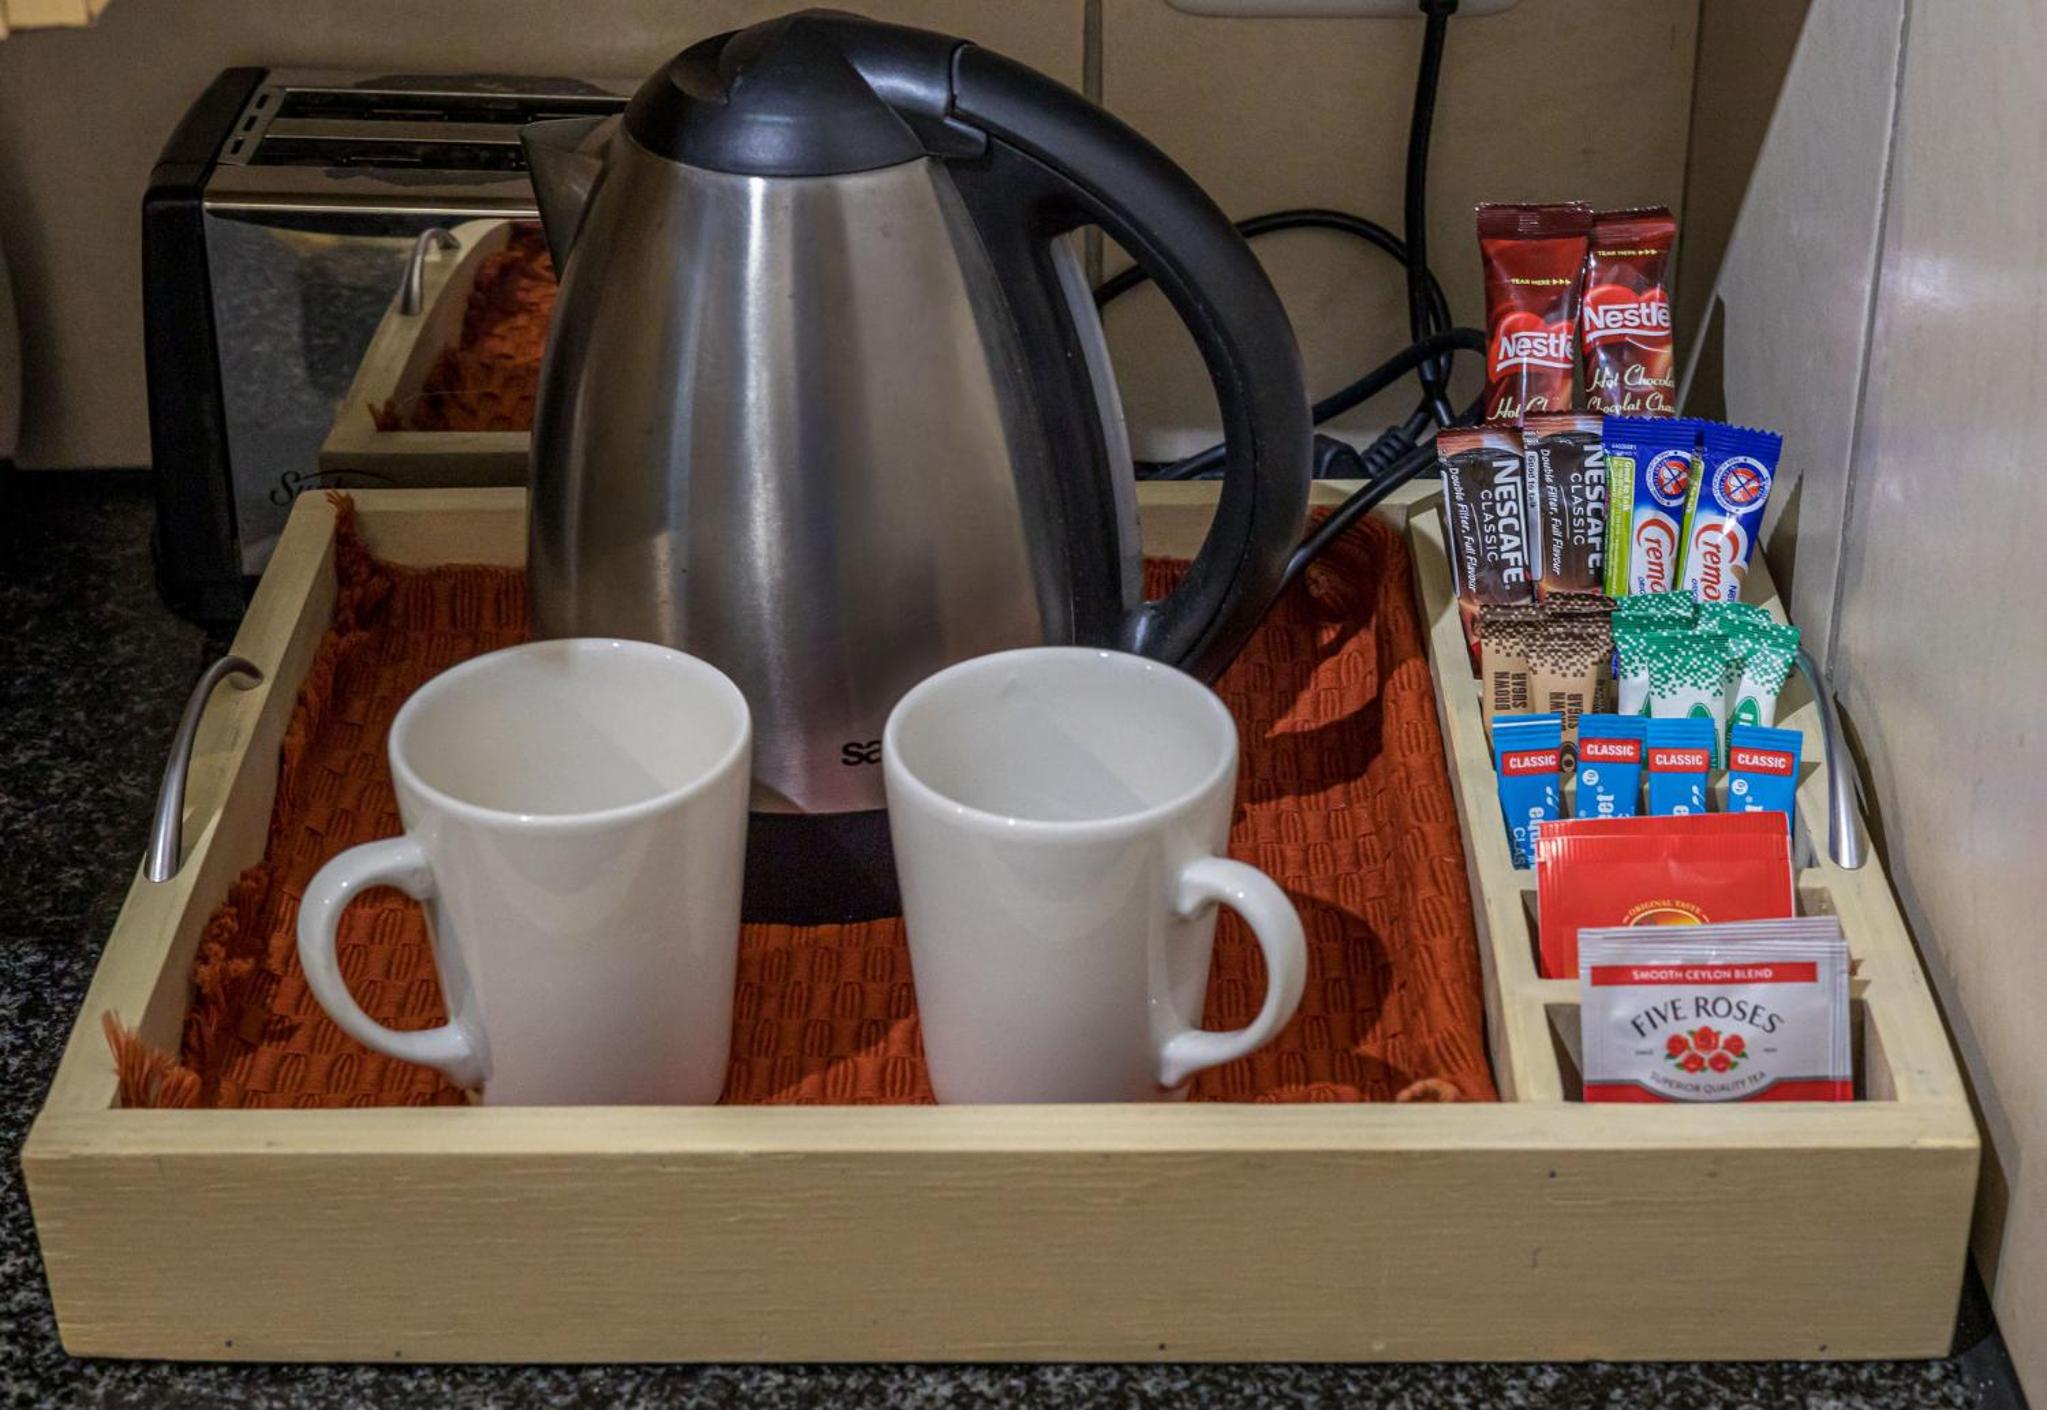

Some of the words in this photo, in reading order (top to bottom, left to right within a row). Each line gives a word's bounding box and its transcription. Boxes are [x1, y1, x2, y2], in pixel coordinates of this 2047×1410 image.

[1586, 366, 1619, 392] Hot
[1486, 396, 1521, 420] Hot
[1541, 449, 1554, 483] Double
[1449, 467, 1463, 503] Double
[1571, 472, 1584, 546] CLASSIC
[1480, 489, 1499, 563] CLASSIC
[1551, 519, 1562, 537] Full
[1464, 535, 1475, 555] Full
[1552, 538, 1563, 576] Flavour
[1465, 555, 1477, 593] Flavour
[1695, 523, 1740, 602] Cremo
[1494, 671, 1511, 711] BROWN
[1511, 672, 1527, 709] SUGAR
[1509, 754, 1557, 769] CLASSIC
[1586, 744, 1634, 757] CLASSIC
[1655, 754, 1703, 766] CLASSIC
[1737, 753, 1787, 769] CLASSIC
[1628, 899, 1673, 916] ORIGINAL
[1632, 969, 1683, 980] SMOOTH
[1685, 969, 1731, 980] CEYLON
[1734, 967, 1773, 979] BLEND
[1630, 998, 1688, 1038] FIVE
[1694, 996, 1784, 1034] ROSES
[1651, 1070, 1700, 1092] SUPERIOR
[1703, 1078, 1746, 1094] QUALITY
[1747, 1071, 1767, 1085] TEA
